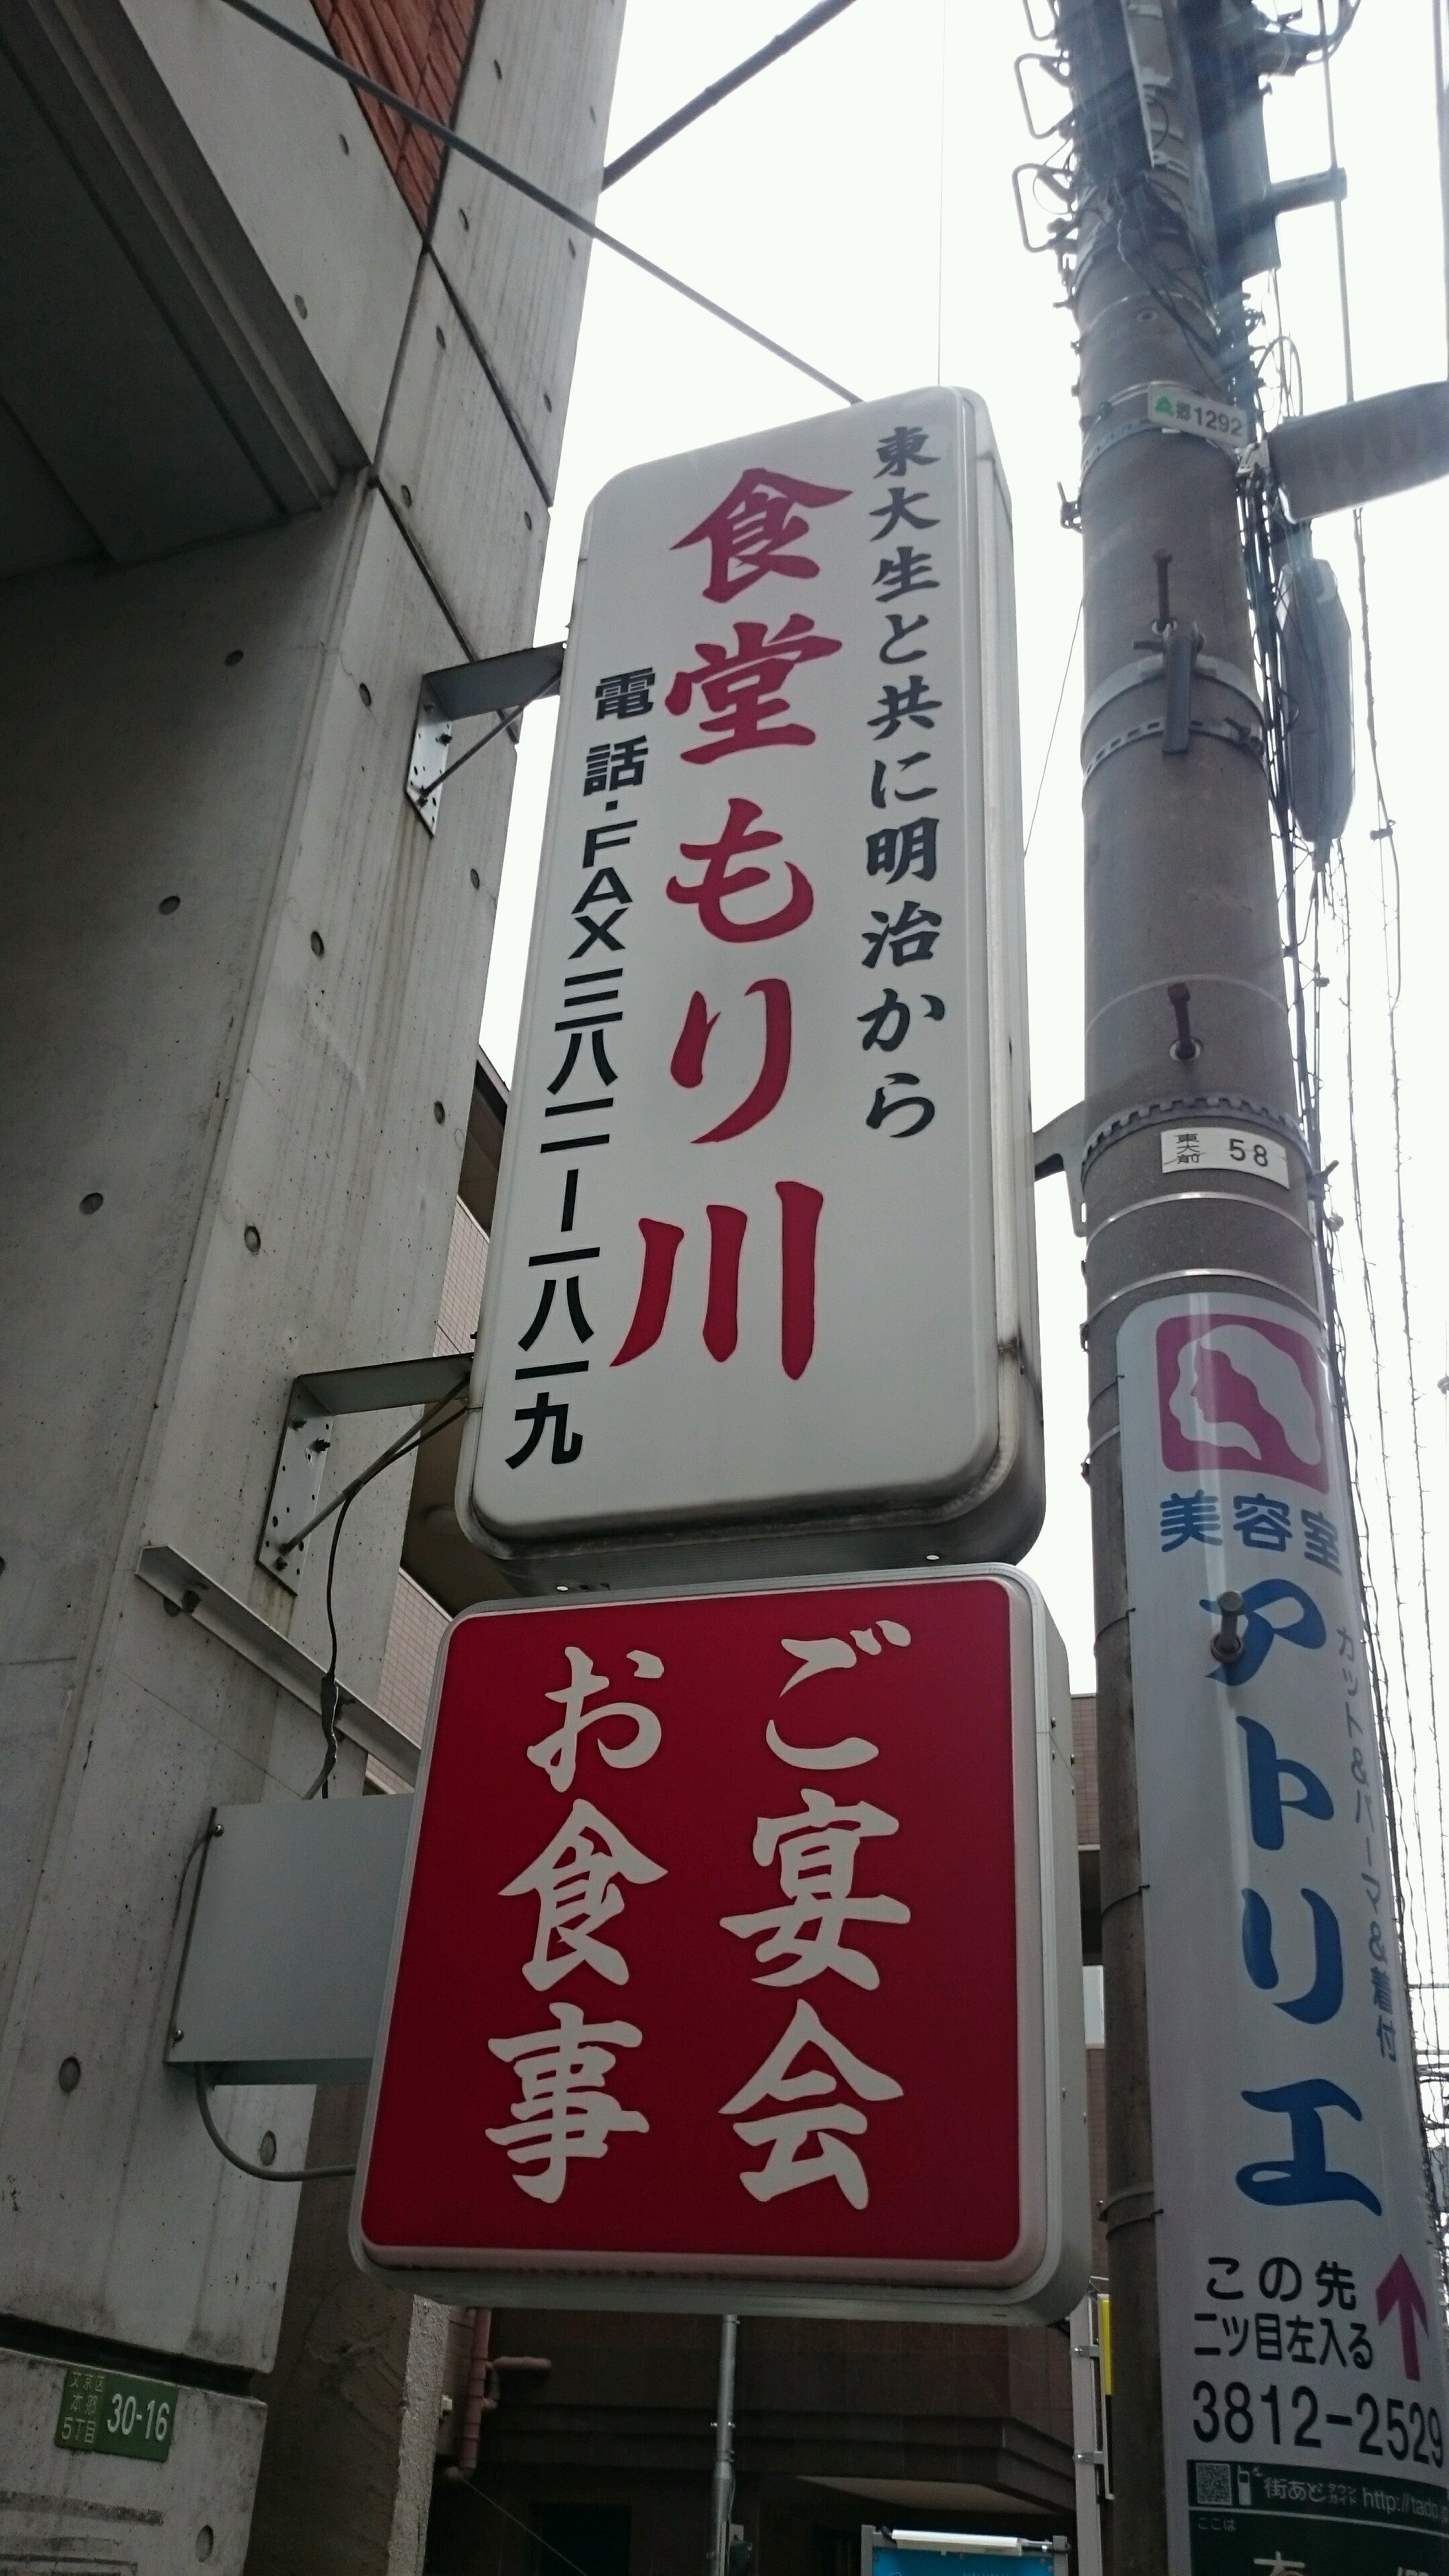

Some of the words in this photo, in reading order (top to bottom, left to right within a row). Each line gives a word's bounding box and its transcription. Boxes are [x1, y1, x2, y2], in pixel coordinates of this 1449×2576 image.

[857, 427, 945, 1138] 東大生と共に明治から
[610, 468, 853, 1380] 食堂もり川
[1229, 1138, 1268, 1167] 58
[1159, 1489, 1342, 1576] 美容室
[485, 1647, 668, 2203] お食事
[718, 1621, 912, 2210] ご宴会
[1199, 1578, 1383, 2216] アトリエ
[1207, 2257, 1356, 2310] この先
[70, 2372, 105, 2392] 文京区
[107, 2393, 170, 2441] 30-16
[1193, 2381, 1443, 2469] 3812-2529
[62, 2416, 96, 2444] 5丁目
[1198, 2517, 1236, 2532] ここは
